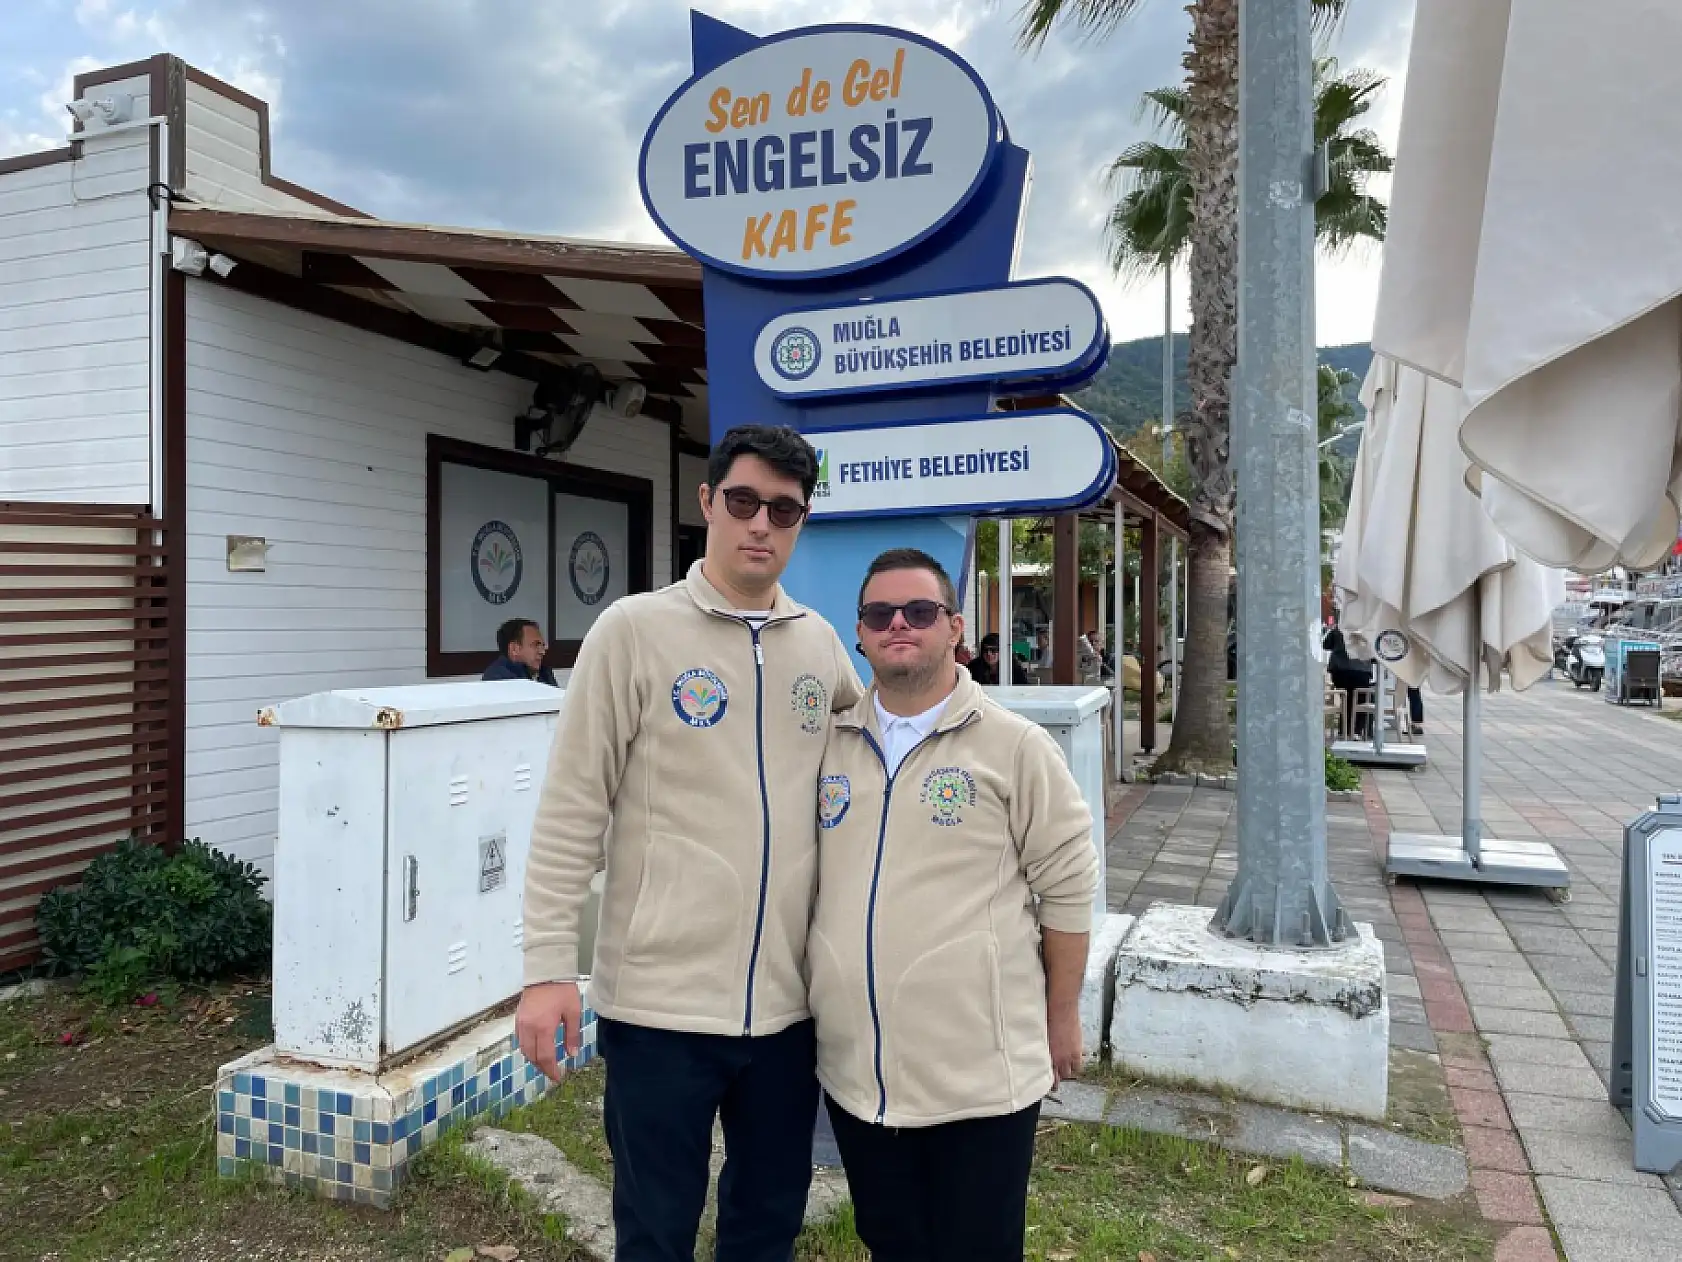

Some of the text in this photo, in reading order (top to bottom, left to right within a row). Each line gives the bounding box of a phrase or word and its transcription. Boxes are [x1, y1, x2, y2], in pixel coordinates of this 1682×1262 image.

[704, 48, 905, 133] Sen de Gel
[684, 108, 933, 199] ENGELSİZ
[741, 200, 857, 260] KAFE
[833, 315, 900, 343] MUĞLA
[834, 324, 1071, 374] BÜYÜKŞEHİR BELEDİYESİ
[840, 445, 1030, 485] FETHİYE BELEDİYESİ
